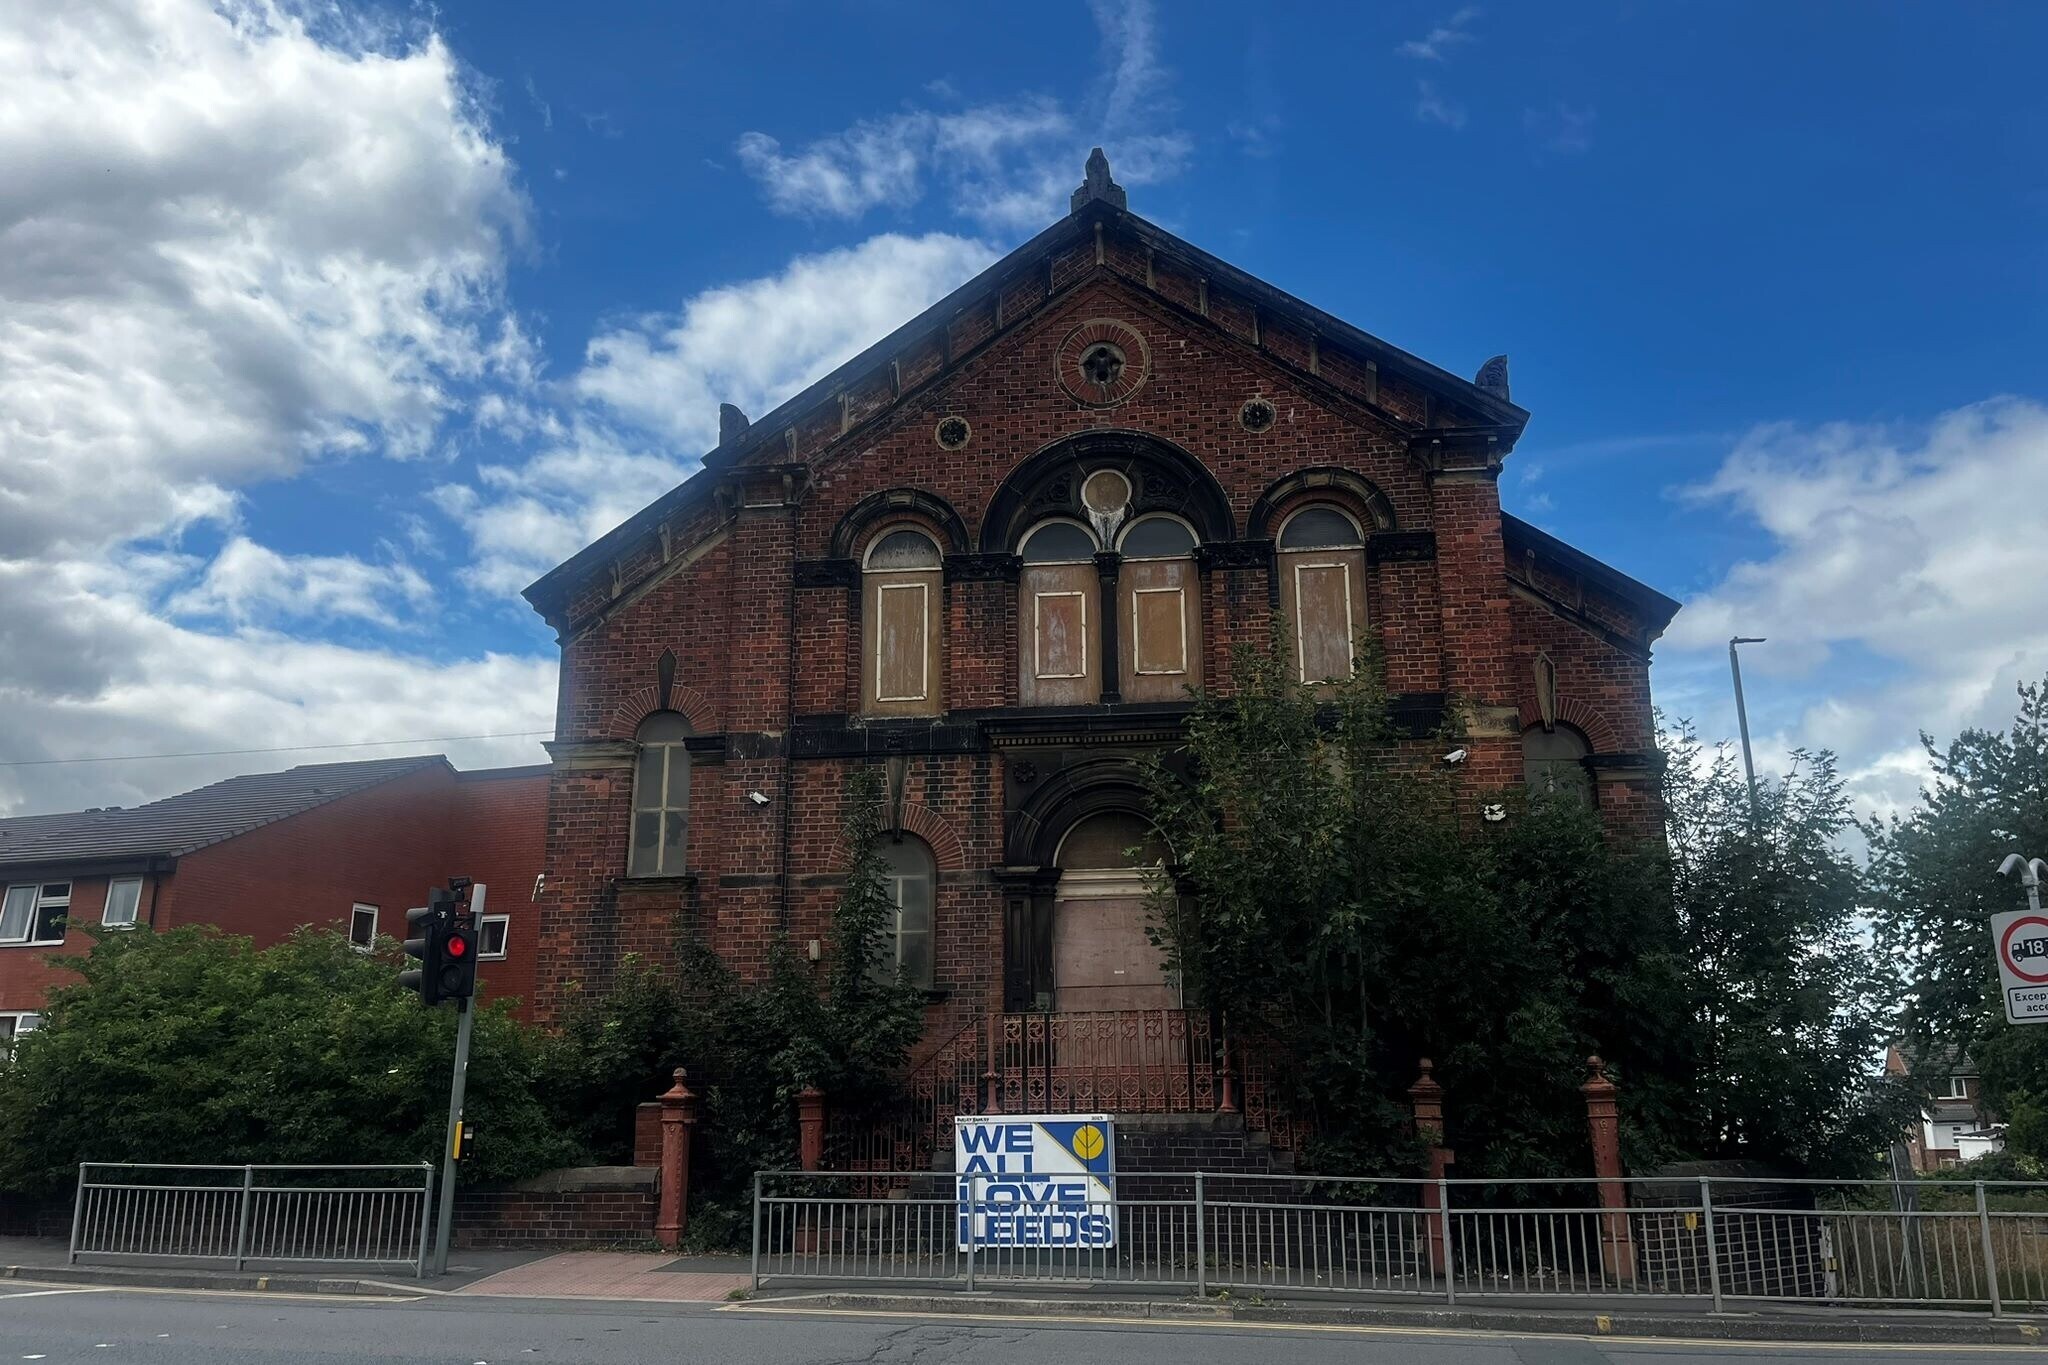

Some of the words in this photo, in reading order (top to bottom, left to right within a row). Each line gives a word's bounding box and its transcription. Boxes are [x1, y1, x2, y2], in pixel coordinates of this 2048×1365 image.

[2014, 992, 2048, 1001] Excep
[961, 1125, 1034, 1153] WE
[959, 1155, 1050, 1183] ALL
[959, 1184, 1087, 1213] LOVE
[959, 1215, 1111, 1245] LEEDS
